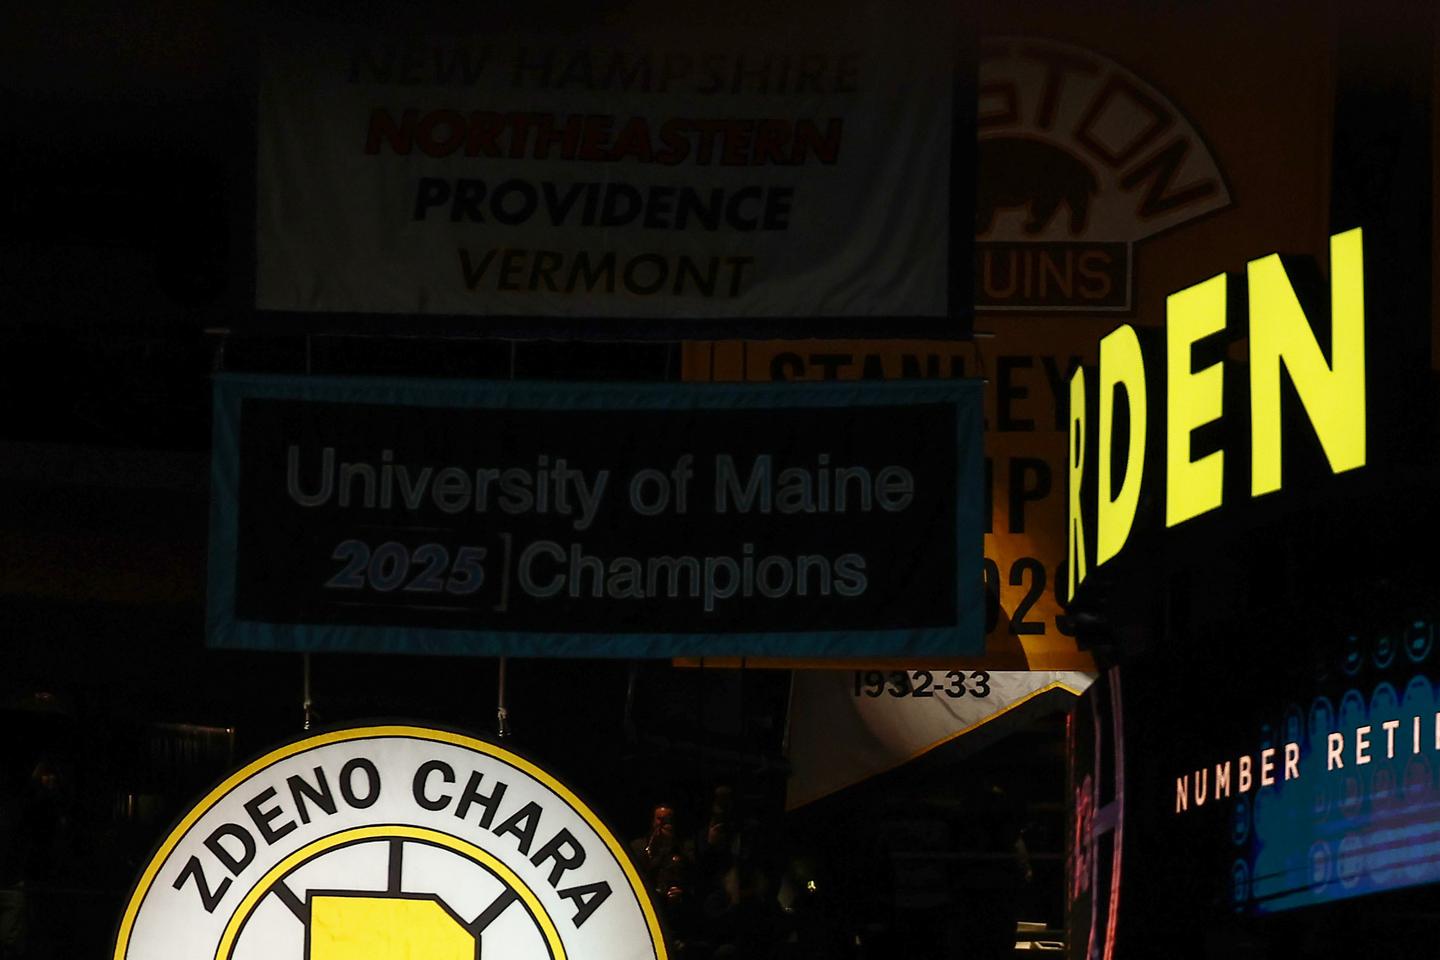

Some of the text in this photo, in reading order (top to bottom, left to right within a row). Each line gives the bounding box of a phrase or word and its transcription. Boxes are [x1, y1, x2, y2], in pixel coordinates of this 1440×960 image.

[347, 46, 863, 95] NEW HAMPSHIRE
[364, 108, 844, 167] NORTHEASTERN
[412, 176, 795, 232] PROVIDENCE
[457, 247, 754, 298] VERMONT
[286, 444, 609, 531] University
[629, 452, 695, 516] of
[713, 452, 915, 515] Maine
[322, 538, 869, 613] 2025 Champions
[854, 671, 991, 699] 1932-33
[1175, 742, 1301, 815] NUMBER
[172, 757, 614, 930] ZDENO CHARA
